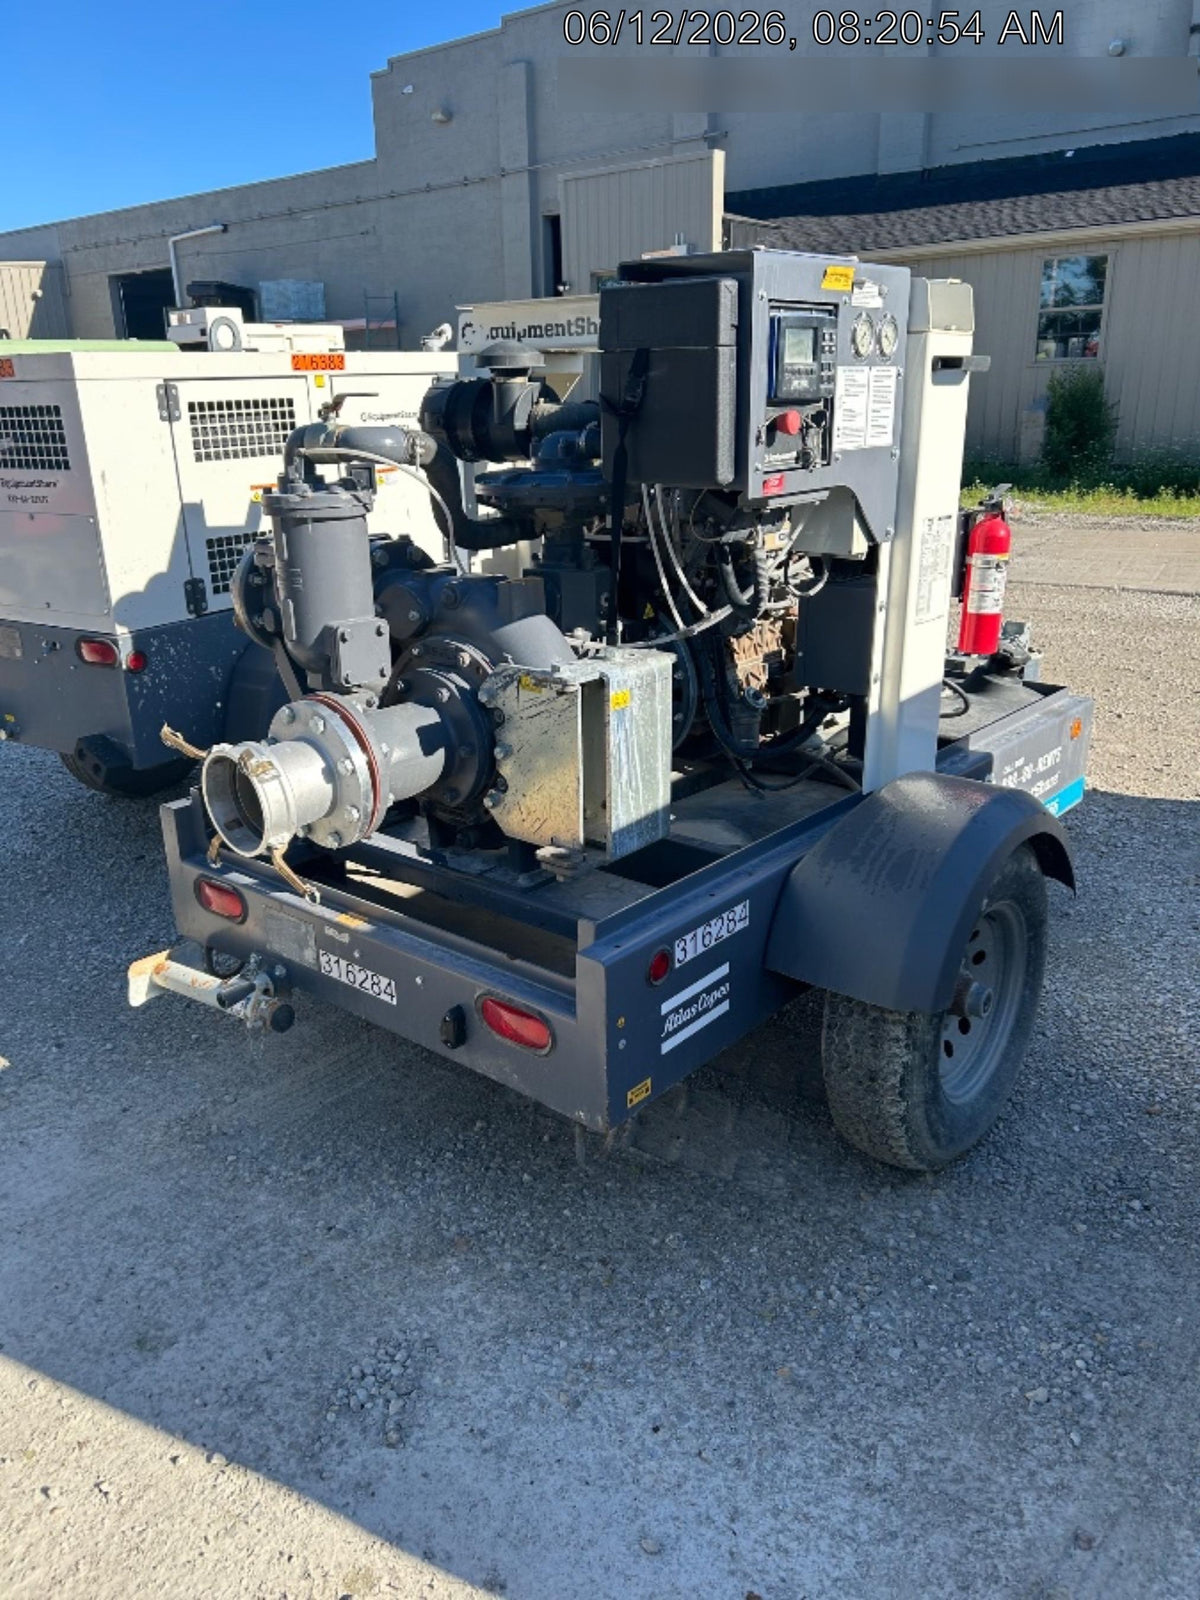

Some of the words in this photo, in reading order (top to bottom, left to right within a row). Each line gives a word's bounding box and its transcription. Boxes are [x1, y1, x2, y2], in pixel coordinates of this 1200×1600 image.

[675, 903, 748, 965] 316284
[320, 952, 396, 1002] 316284
[660, 1004, 697, 1038] Atlas
[697, 982, 730, 1010] Copco
